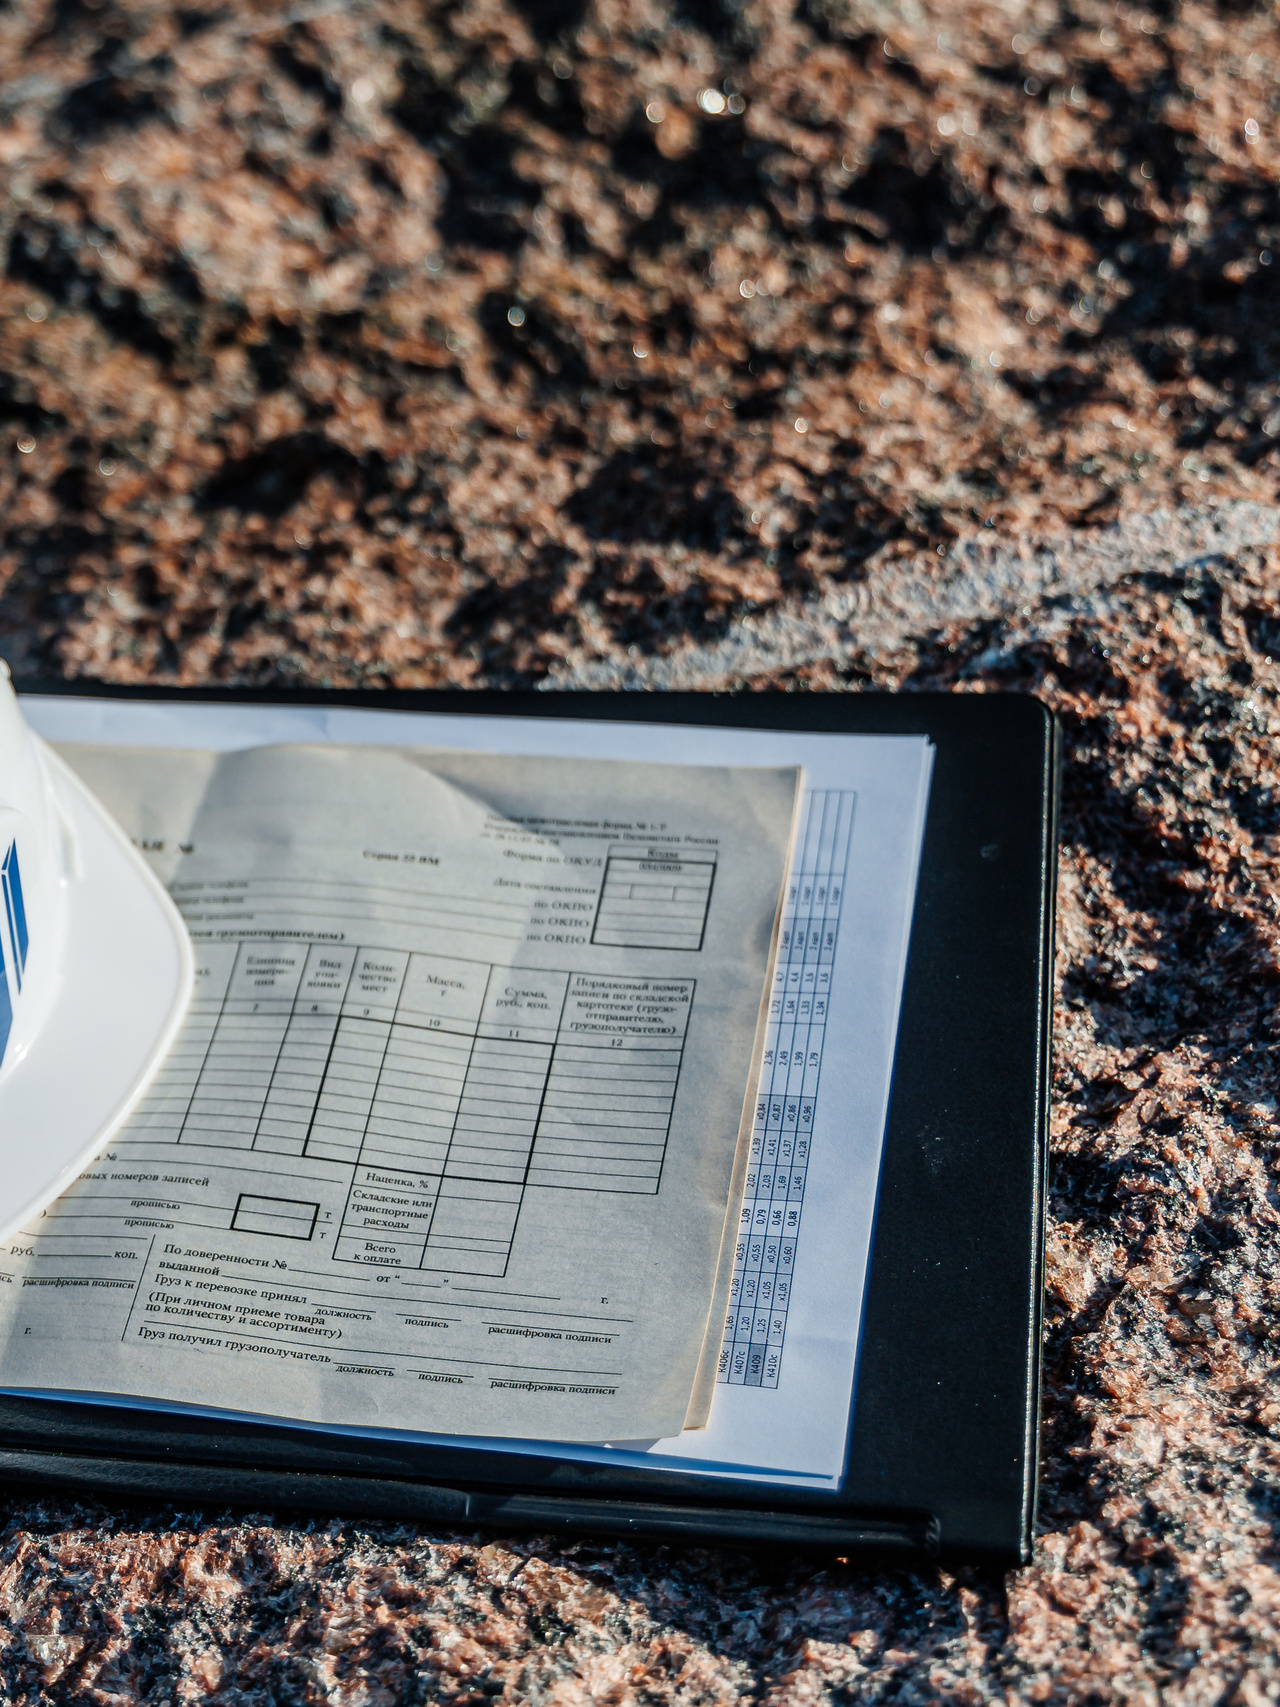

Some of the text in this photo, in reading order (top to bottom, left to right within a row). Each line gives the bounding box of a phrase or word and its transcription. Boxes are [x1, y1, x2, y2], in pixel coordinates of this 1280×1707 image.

[551, 901, 593, 912] ОКПО
[548, 917, 590, 928] ОКПО
[545, 934, 586, 944] ОКПО
[576, 977, 688, 995] Порядковый номер
[612, 993, 627, 1001] по
[629, 993, 689, 1004] складской
[362, 1007, 371, 1017] 9
[576, 1002, 677, 1016] картотеке (грузо-
[428, 1019, 441, 1028] 10
[585, 1011, 664, 1025] отправителю,
[508, 1030, 521, 1039] 11
[570, 1022, 677, 1036] грузополучателю)
[611, 1038, 624, 1047] 12
[103, 1152, 118, 1162] №
[110, 1171, 159, 1183] номеров
[161, 1173, 210, 1188] записей
[366, 1172, 429, 1190] Наценка, %
[741, 1316, 751, 1332] 1,20
[756, 1209, 767, 1225] 0,79
[762, 1174, 771, 1189] 2,03
[779, 1051, 788, 1066] 2,49
[757, 1318, 766, 1333] 1,25
[772, 1210, 782, 1226] 0,66
[778, 1175, 787, 1189] 1,69
[794, 1051, 804, 1066] 1,99
[773, 1319, 783, 1335] 1,40
[788, 1210, 798, 1227] 0,88
[793, 1176, 802, 1190] 1,46
[809, 1052, 819, 1067] 1,79
[130, 1199, 181, 1211] прописью
[352, 1189, 433, 1209] Складские или
[351, 1202, 429, 1220] транспортные
[123, 1218, 175, 1230] прописью
[363, 1217, 410, 1230] расходы
[10, 1246, 139, 1260] руб. коп.
[364, 1242, 396, 1254] Всего
[725, 1315, 734, 1330] 1,65
[741, 1208, 751, 1223] 1,09
[747, 1173, 756, 1187] 2,02
[163, 1243, 391, 1283] По доверенности № от
[363, 1254, 402, 1266] оплате
[158, 1259, 221, 1277] выданной
[22, 1278, 89, 1288] расшифровка
[91, 1280, 135, 1290] подписи
[154, 1274, 308, 1305] Груз к перевозке принял
[148, 1291, 326, 1326] (При личном приеме товара
[145, 1303, 343, 1340] по количеству и ассортименту)
[314, 1307, 612, 1344] должность подпись расшифровка подписи
[138, 1327, 332, 1364] Груз получил грузополучатель
[335, 1364, 616, 1395] должность подпись расшифровка подписи
